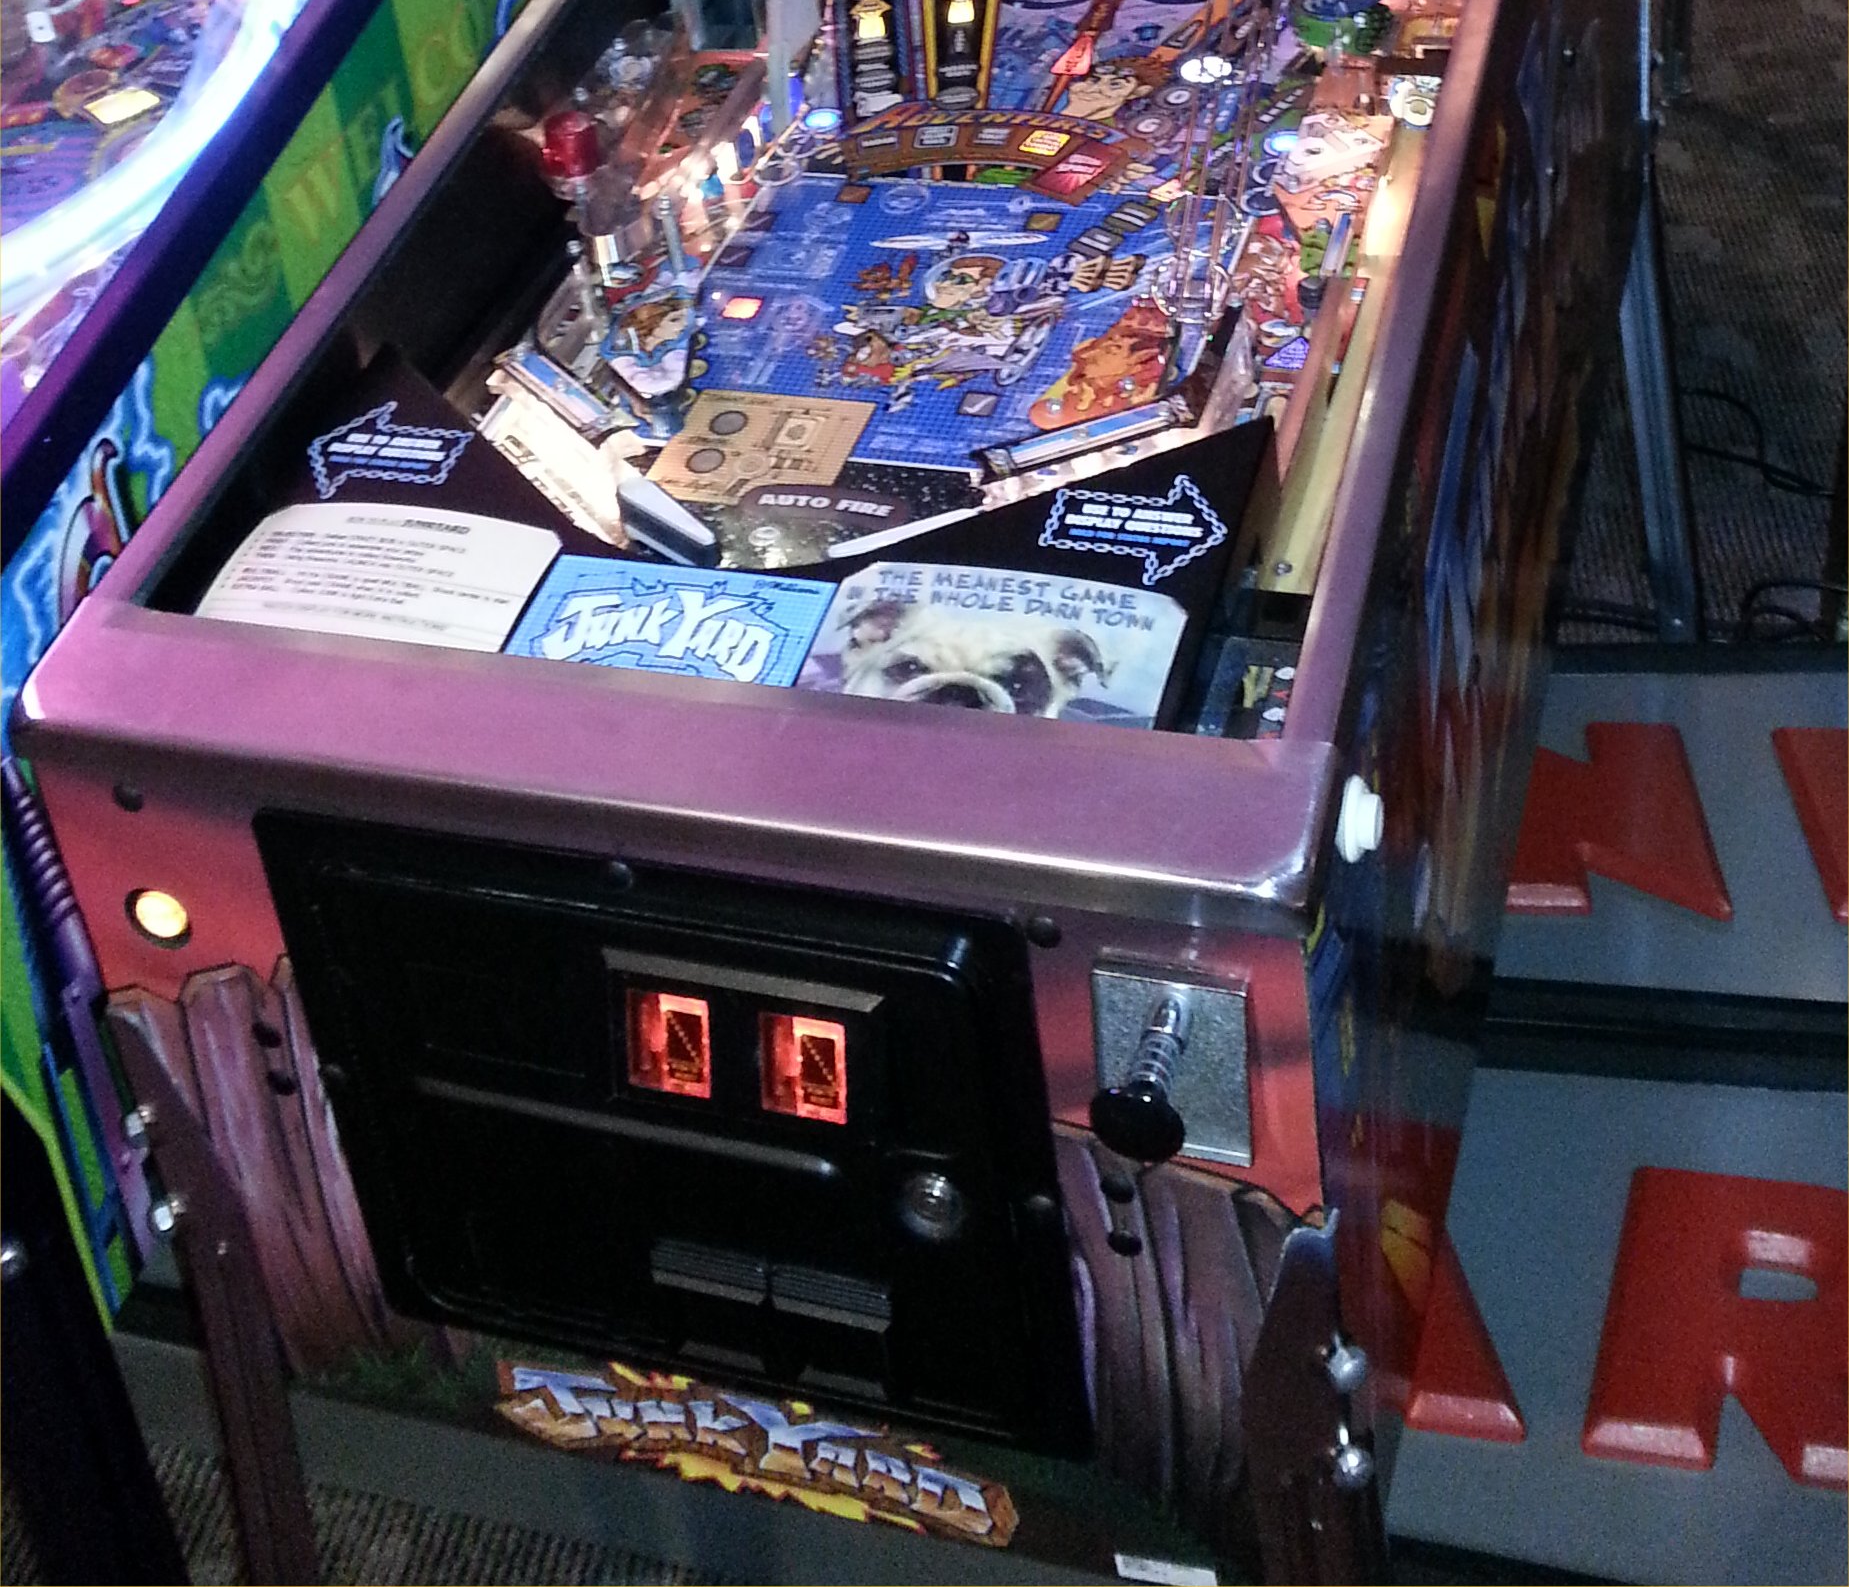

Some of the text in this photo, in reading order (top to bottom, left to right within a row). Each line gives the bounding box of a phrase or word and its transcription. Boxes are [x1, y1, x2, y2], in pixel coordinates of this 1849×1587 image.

[757, 493, 895, 518] AUTO FIRE
[873, 587, 919, 605] THE
[929, 589, 1015, 614] WHOLE
[1023, 598, 1084, 623] DARN
[1092, 607, 1157, 632] TOWN
[879, 570, 1138, 611] THE MEANEST GAME
